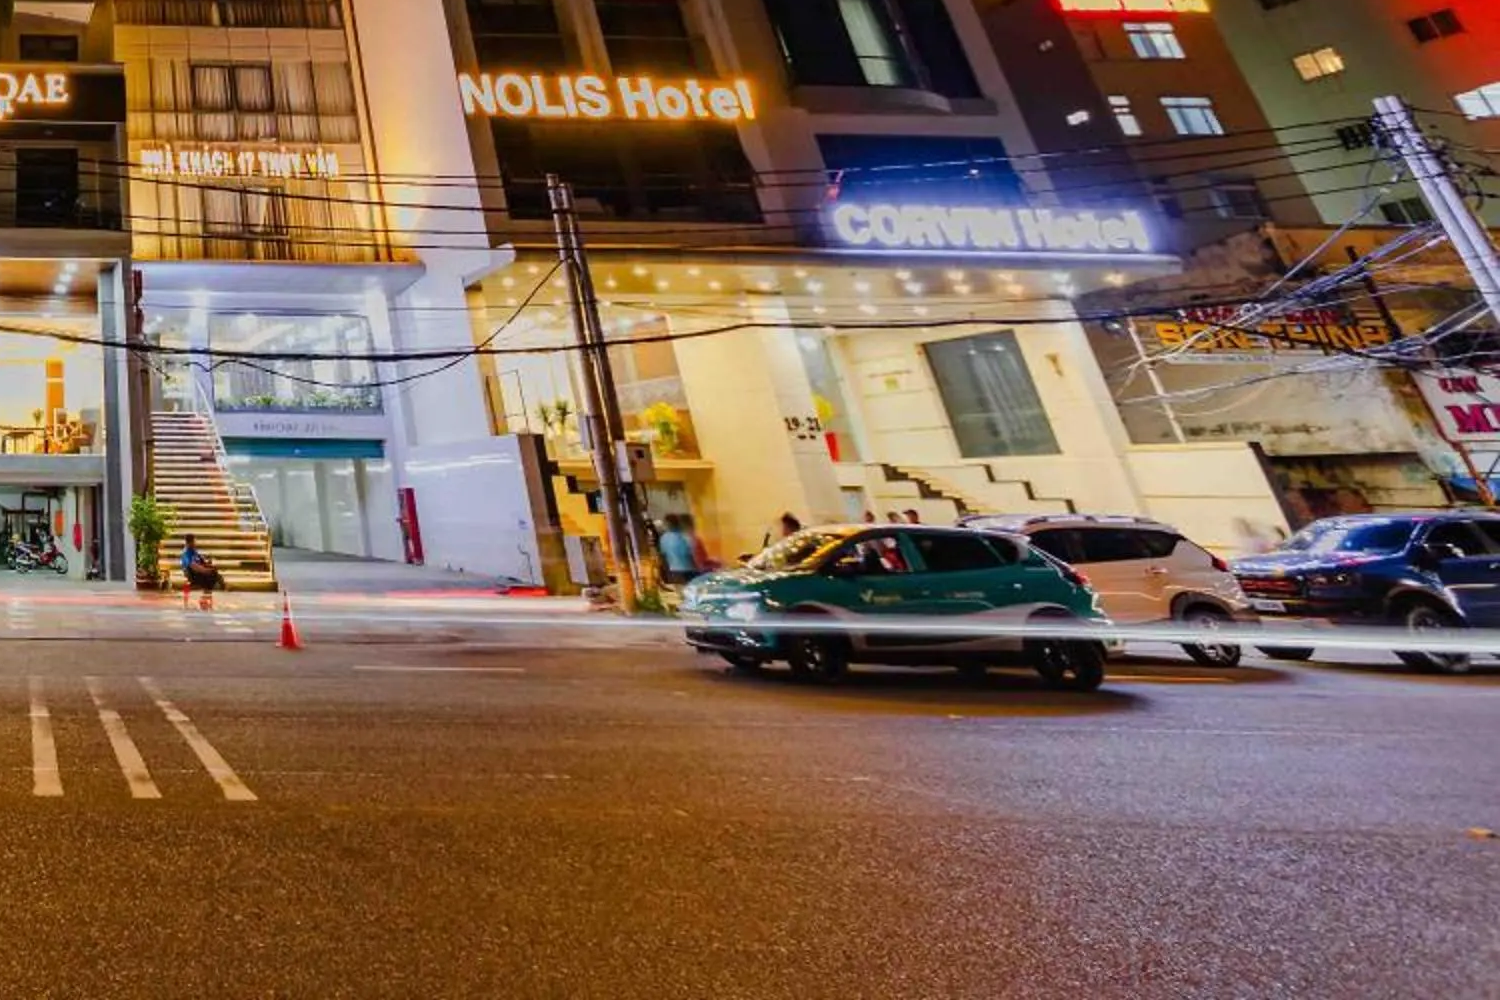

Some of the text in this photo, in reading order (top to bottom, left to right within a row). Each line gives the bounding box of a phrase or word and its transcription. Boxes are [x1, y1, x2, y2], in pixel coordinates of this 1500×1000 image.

[458, 73, 756, 121] NOLIS Hotel
[833, 203, 1151, 252] CORVIN Hotel
